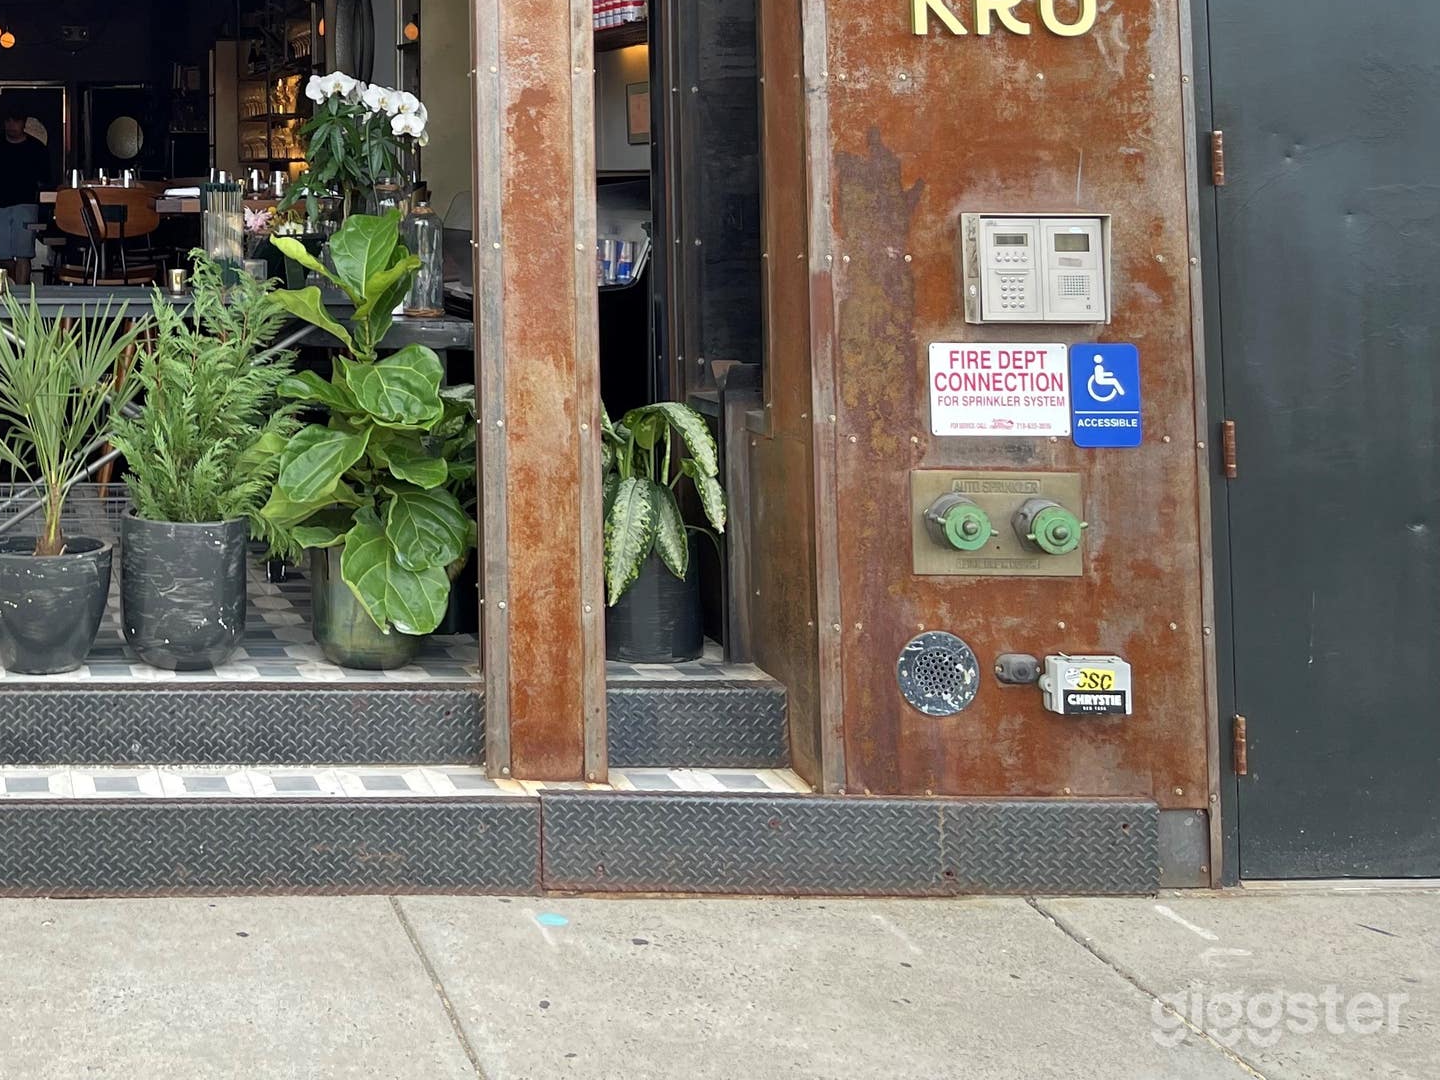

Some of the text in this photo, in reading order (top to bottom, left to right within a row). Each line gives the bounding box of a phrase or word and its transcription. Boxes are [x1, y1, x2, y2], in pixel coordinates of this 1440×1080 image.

[949, 350, 1048, 369] FIRE DEPT
[934, 372, 1064, 392] CONNECTION
[938, 395, 1065, 407] FOR SPRINKLER SYSTEM
[1077, 418, 1138, 428] ACCESSIBLE
[1067, 694, 1122, 706] CHRYSTIE
